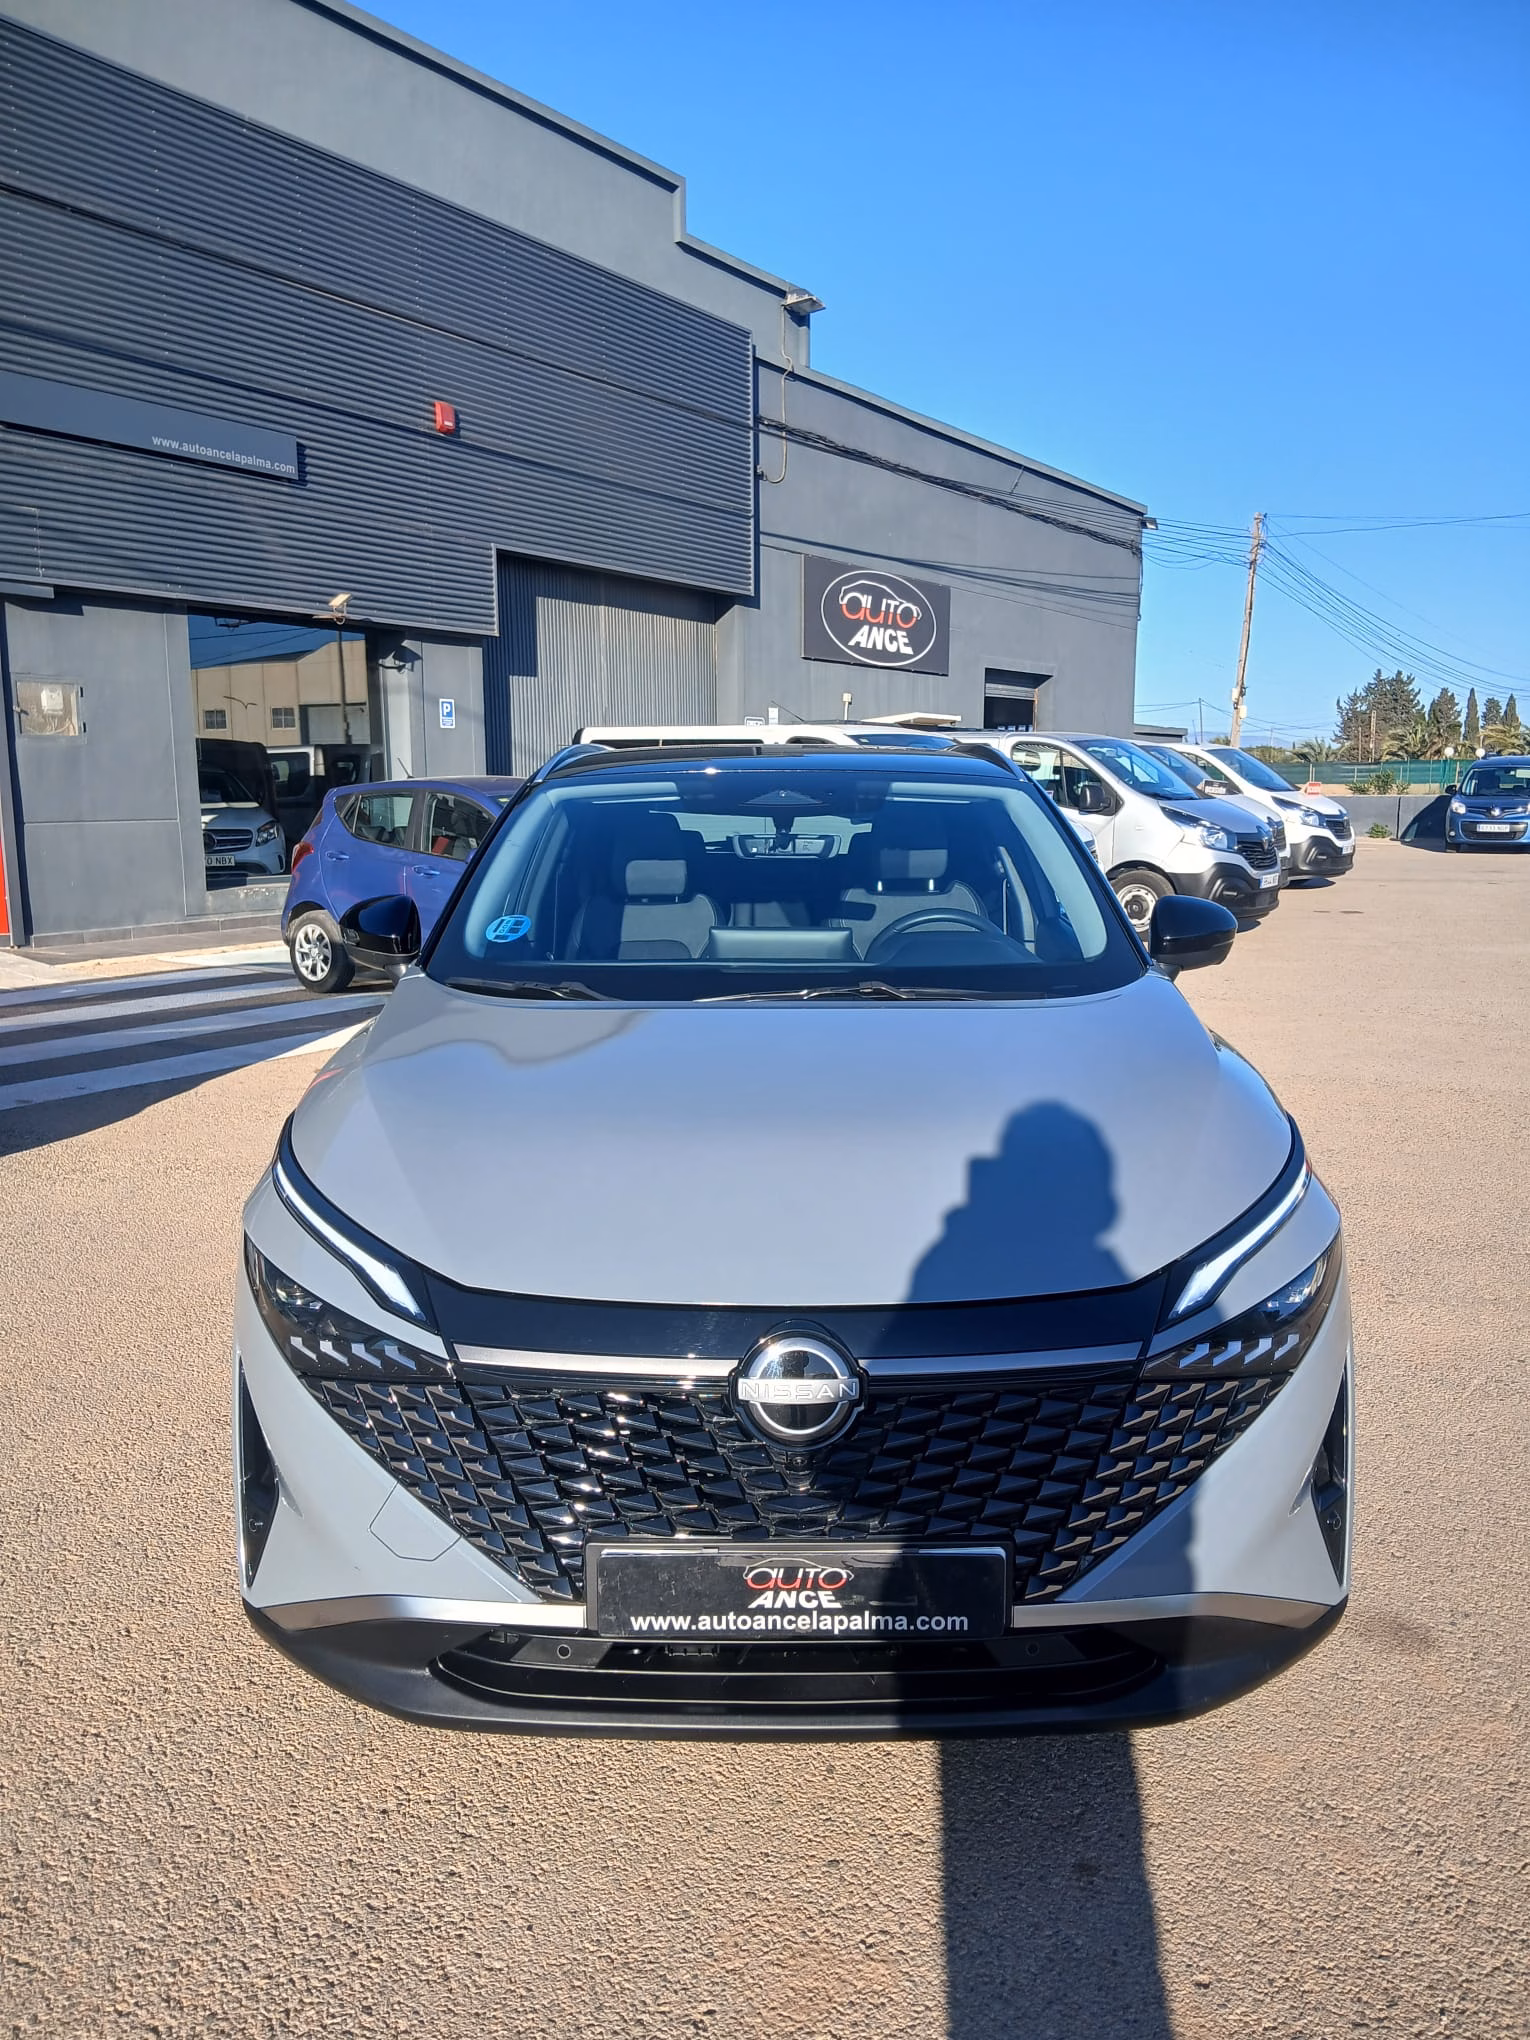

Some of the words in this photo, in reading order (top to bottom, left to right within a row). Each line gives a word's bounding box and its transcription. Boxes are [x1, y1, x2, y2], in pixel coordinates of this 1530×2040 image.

[151, 435, 296, 474] www.autoancelapalma.com
[848, 625, 914, 655] ANCE
[215, 856, 233, 865] NBX
[741, 1382, 856, 1401] NISSAN
[748, 1590, 842, 1609] ANCE
[630, 1611, 969, 1634] www.autoancelapalma.com
